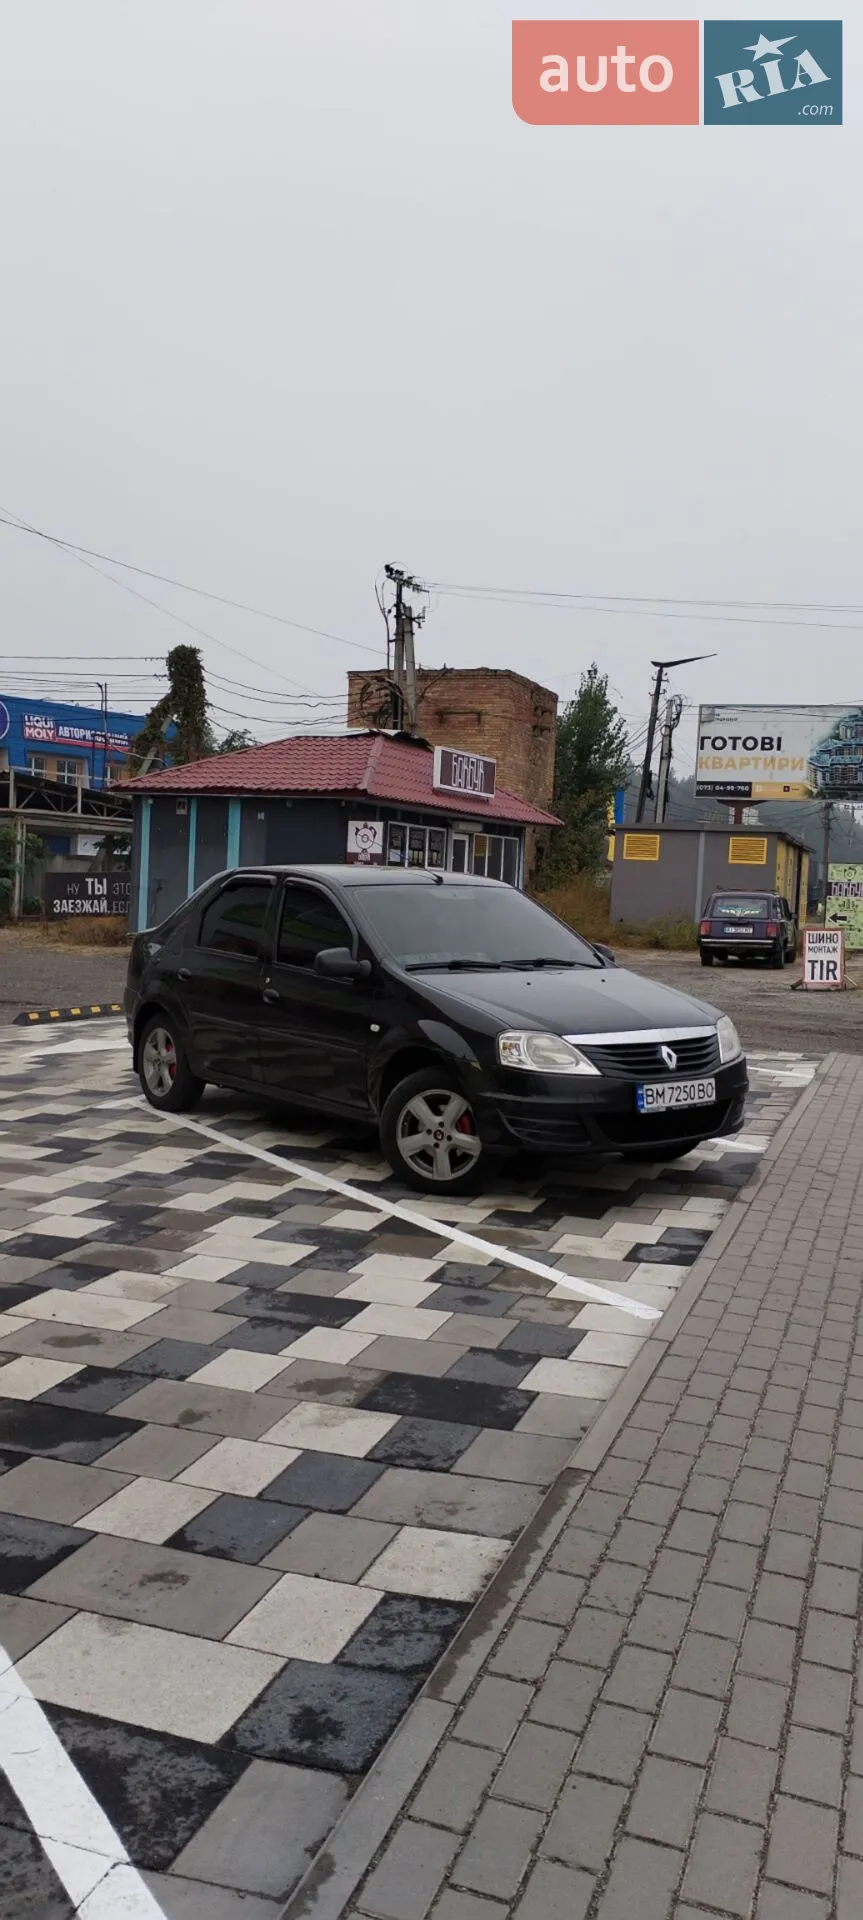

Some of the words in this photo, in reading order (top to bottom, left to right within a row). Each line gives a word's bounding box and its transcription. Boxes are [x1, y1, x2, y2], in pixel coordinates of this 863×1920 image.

[24, 713, 54, 729] LIQUI
[25, 726, 54, 741] MOLY
[699, 735, 783, 752] ГОТОВІ
[698, 756, 805, 771] КВАРТИРИ
[66, 883, 80, 895] НУ
[85, 877, 107, 895] ТЫ
[807, 932, 839, 944] ШИНО
[807, 945, 839, 954] МОНТАЖ
[807, 959, 838, 981] TIR
